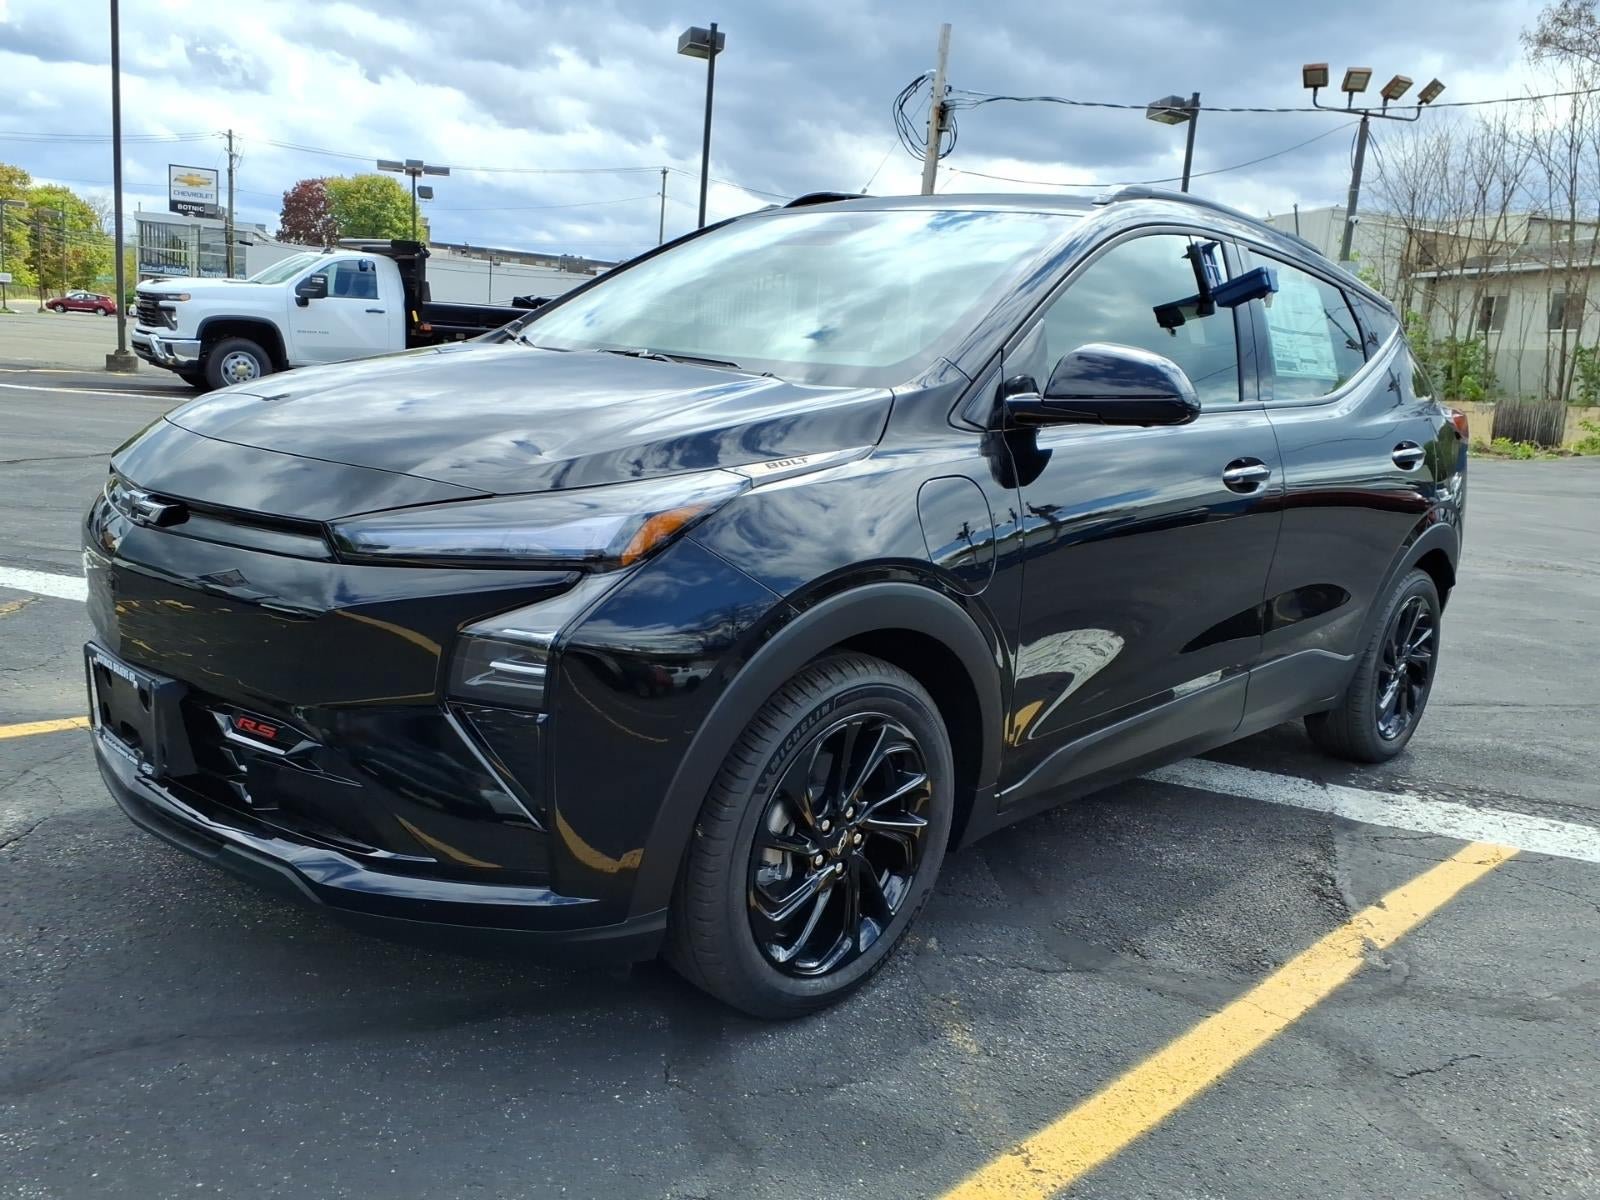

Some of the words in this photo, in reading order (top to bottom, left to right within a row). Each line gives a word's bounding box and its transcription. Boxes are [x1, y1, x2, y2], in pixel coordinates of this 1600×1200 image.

[173, 189, 213, 199] CHEVROLET
[177, 203, 205, 212] BOTNIC
[765, 457, 808, 469] BOLT
[238, 717, 277, 739] RS
[768, 703, 831, 772] MICHELIN
